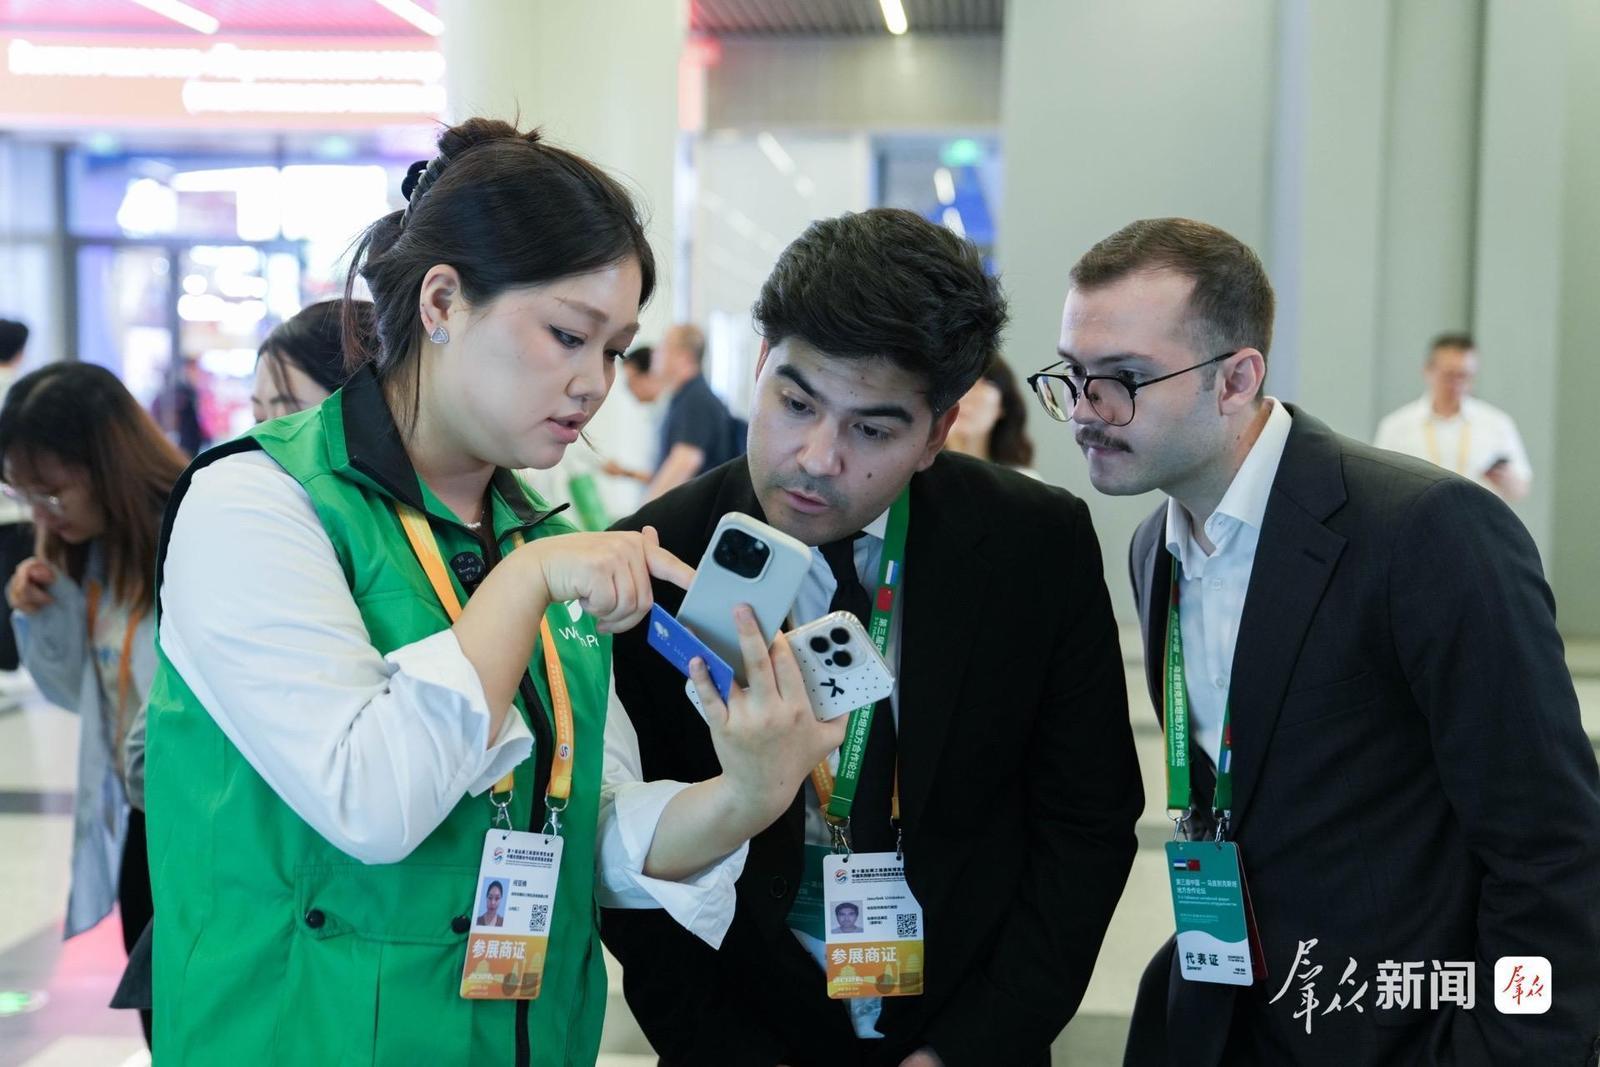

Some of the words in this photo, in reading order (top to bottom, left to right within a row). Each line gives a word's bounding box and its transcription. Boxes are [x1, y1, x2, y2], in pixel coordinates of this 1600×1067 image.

[472, 938, 527, 960] 参展商证
[831, 946, 897, 965] 参展商证
[1185, 951, 1219, 967] 代表证
